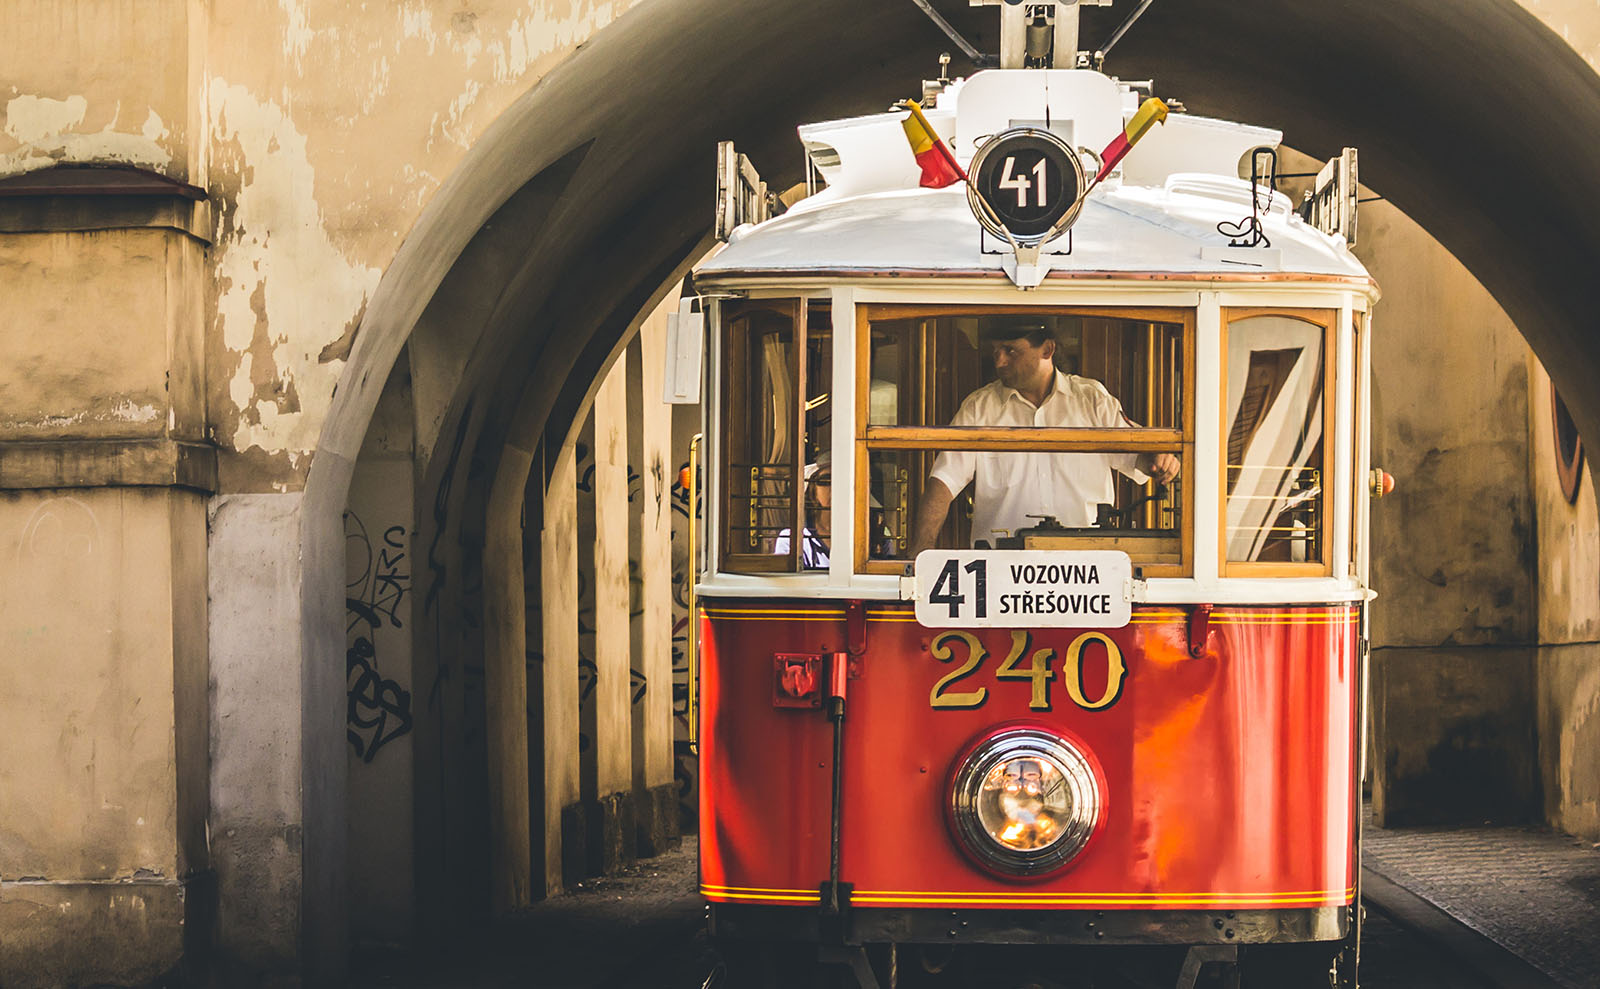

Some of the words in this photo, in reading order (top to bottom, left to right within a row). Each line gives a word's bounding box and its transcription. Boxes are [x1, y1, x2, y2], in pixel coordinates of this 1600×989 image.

[998, 156, 1047, 207] 41
[929, 559, 987, 618] 41
[1010, 564, 1100, 584] VOZOVNA
[999, 591, 1111, 614] STŘEŠOVICE
[929, 631, 1128, 711] 240
